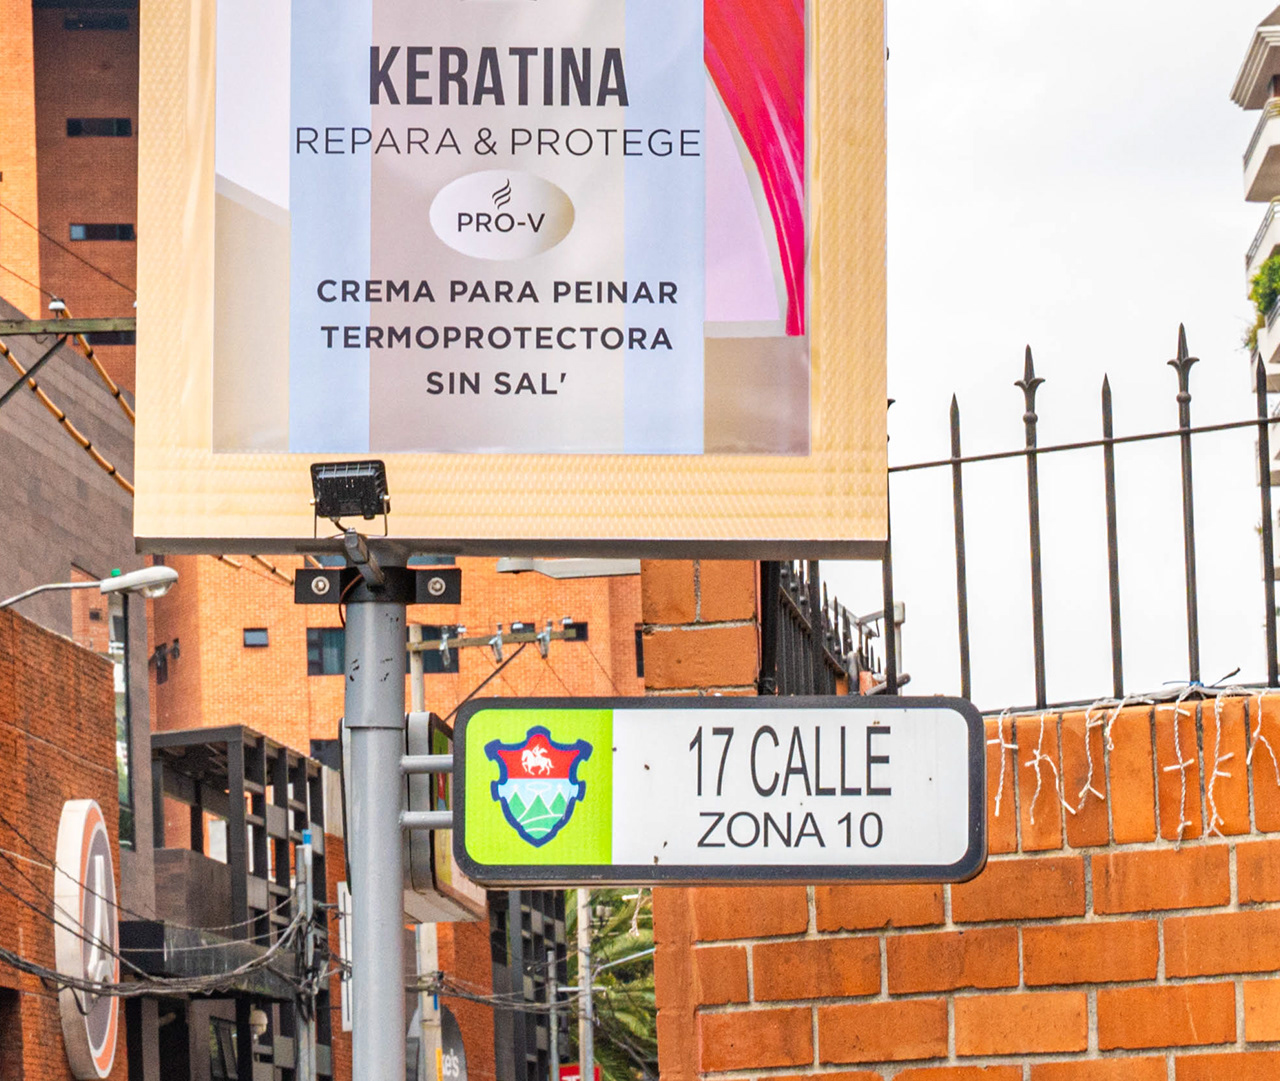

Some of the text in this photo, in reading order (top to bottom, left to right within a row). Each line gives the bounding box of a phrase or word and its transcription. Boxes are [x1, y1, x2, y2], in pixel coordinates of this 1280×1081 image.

[369, 46, 629, 107] KERATINA
[296, 127, 701, 157] REPARA & PROTEGE
[457, 213, 545, 233] PRO-V
[317, 280, 678, 304] CREMA PARA PEINAR
[321, 325, 673, 350] TERMOPROTECTORA
[426, 371, 480, 395] SIN
[689, 725, 892, 797] 17 CALLE
[697, 812, 883, 848] ZONA 10
